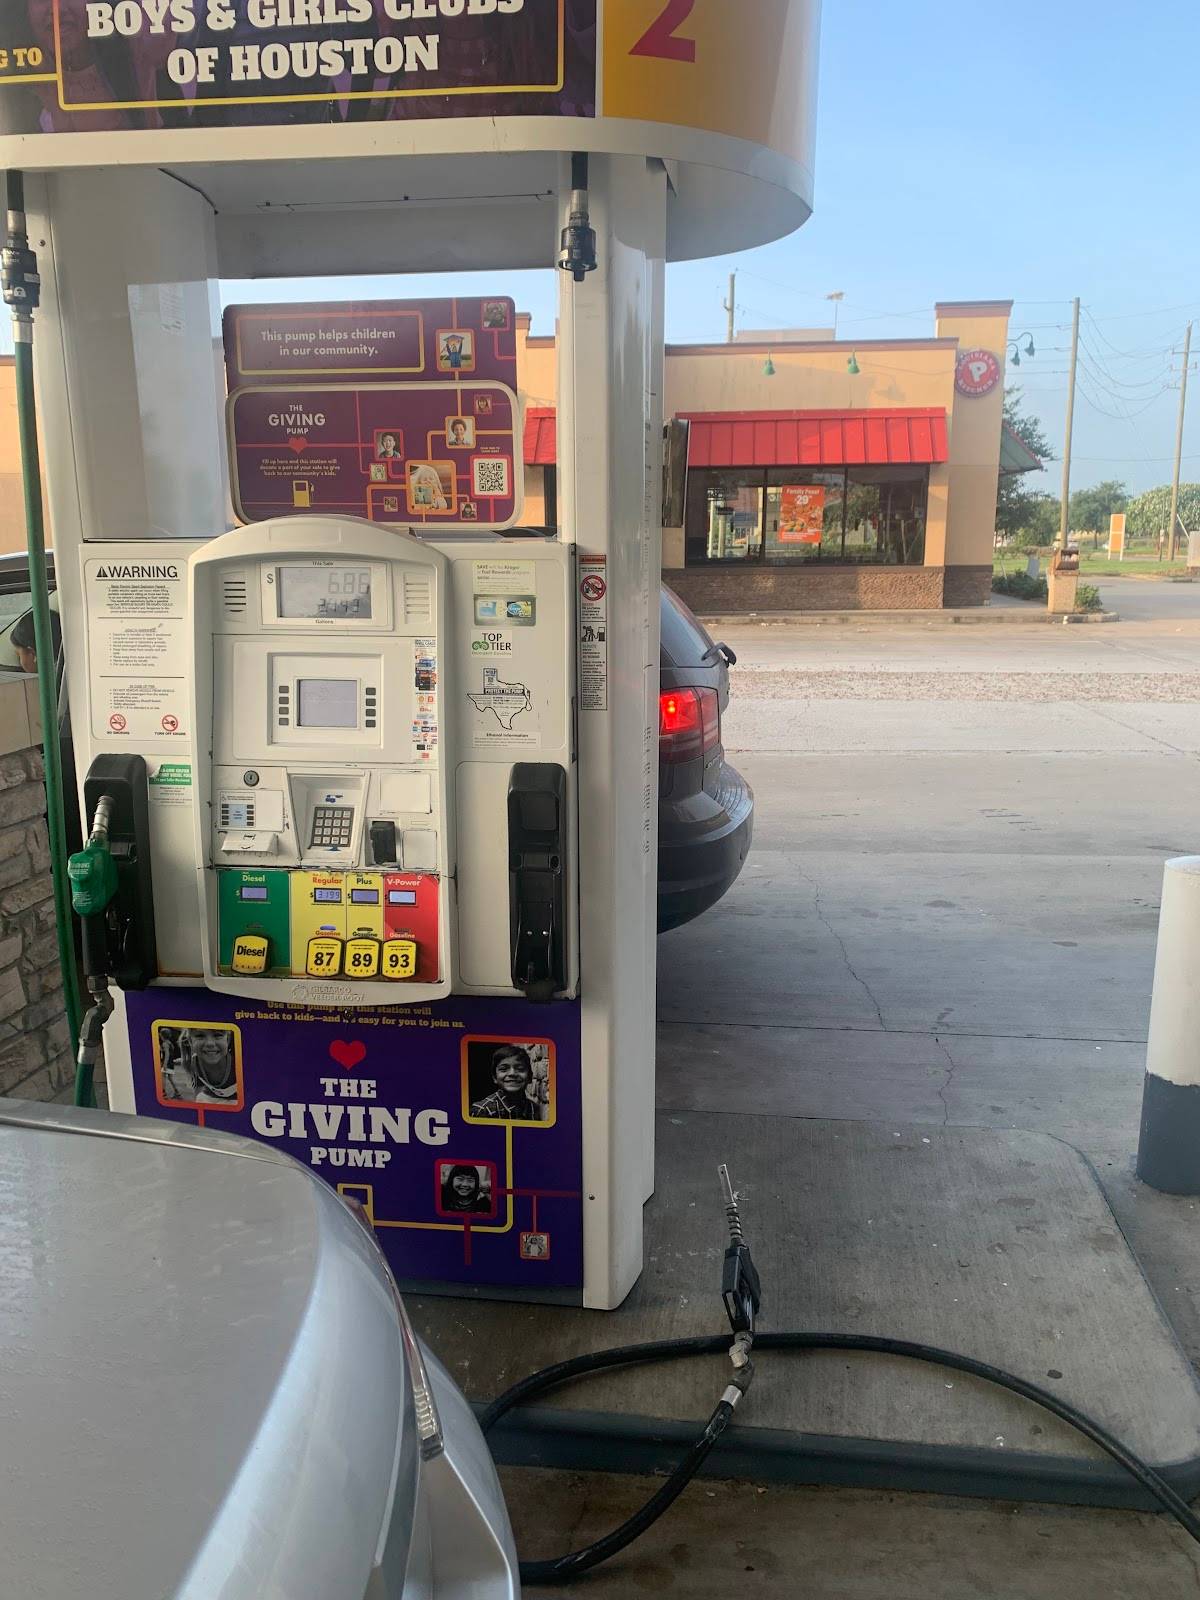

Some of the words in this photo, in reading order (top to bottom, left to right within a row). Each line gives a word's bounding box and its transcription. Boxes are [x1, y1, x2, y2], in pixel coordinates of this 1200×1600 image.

[86, 0, 195, 37] BOYS
[207, 0, 236, 30] &
[247, 0, 372, 28] GIRLS
[628, 0, 696, 63] 2
[13, 47, 42, 66] TO
[167, 46, 218, 84] OF
[230, 34, 439, 80] HOUSTON
[261, 330, 281, 341] This
[285, 331, 316, 343] pump
[319, 328, 348, 342] helps
[351, 328, 395, 339] children
[280, 345, 289, 355] in
[293, 346, 311, 356] our
[314, 344, 379, 357] community.
[268, 413, 326, 426] GIVING
[286, 427, 309, 435] PUMP
[108, 566, 178, 578] WARNING
[482, 633, 502, 642] TOP
[490, 642, 512, 650] TIER
[313, 877, 343, 885] Regular
[387, 878, 420, 886] V-Power
[236, 945, 265, 957] Diesel
[314, 952, 335, 967] 87
[352, 953, 373, 967] 89
[389, 954, 410, 968] 93
[267, 1001, 284, 1009] Use
[307, 1004, 335, 1012] pump
[377, 1005, 411, 1014] station
[413, 1007, 431, 1015] will
[235, 1010, 255, 1019] give
[257, 1010, 280, 1020] back
[282, 1012, 292, 1020] to
[358, 1016, 379, 1025] easy
[381, 1016, 395, 1025] for
[398, 1018, 416, 1027] you
[419, 1018, 429, 1026] to
[430, 1018, 449, 1028] join
[320, 1078, 377, 1098] THE
[251, 1101, 450, 1146] GIVING
[310, 1147, 391, 1168] PUMP
